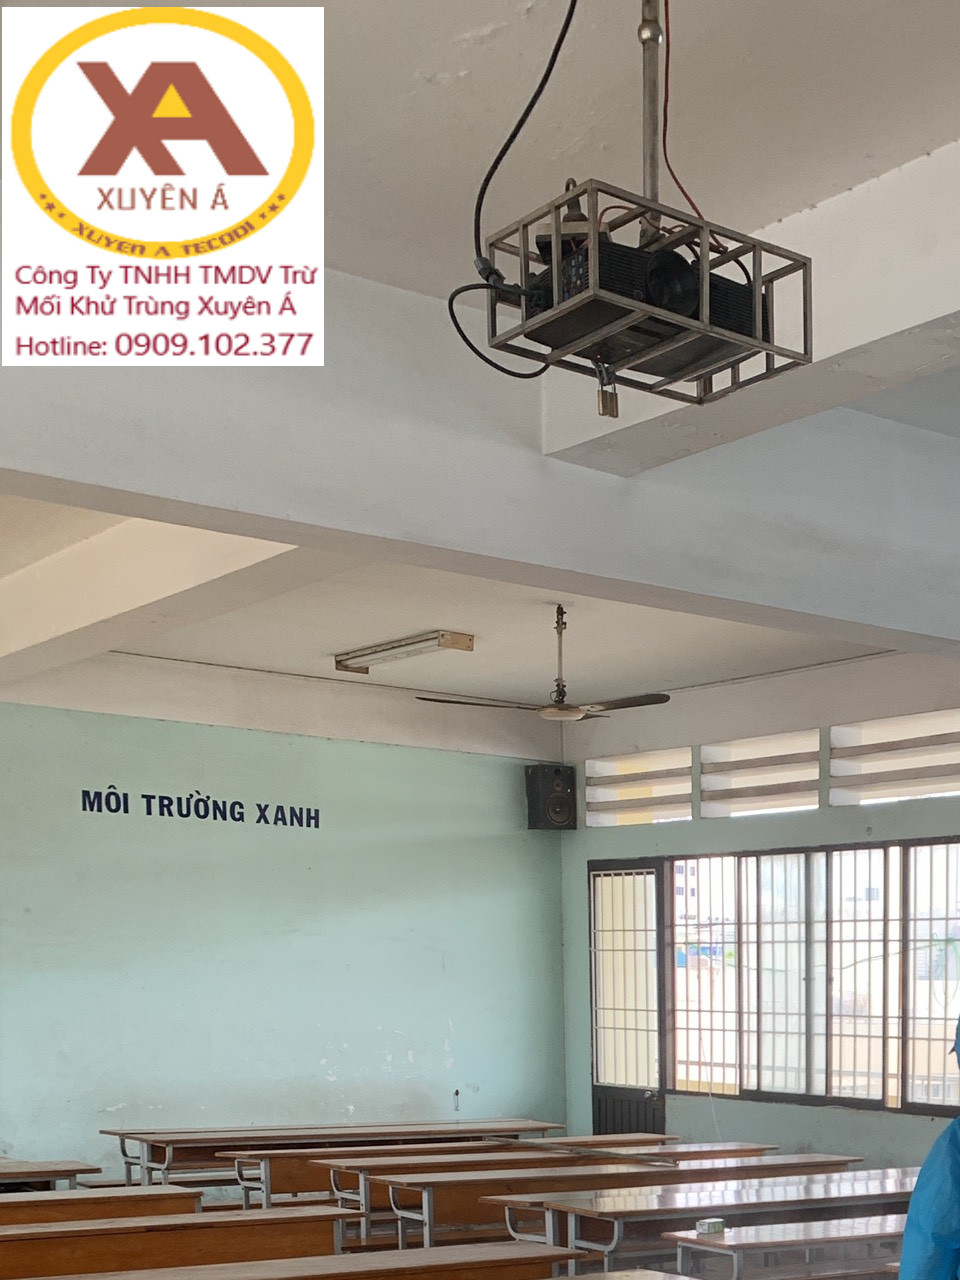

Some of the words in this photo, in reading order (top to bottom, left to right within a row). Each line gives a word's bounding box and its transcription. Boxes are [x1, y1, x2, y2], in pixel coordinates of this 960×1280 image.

[81, 785, 130, 814] MÔI
[141, 790, 245, 823] TRƯỜNG
[255, 803, 320, 829] XANH
